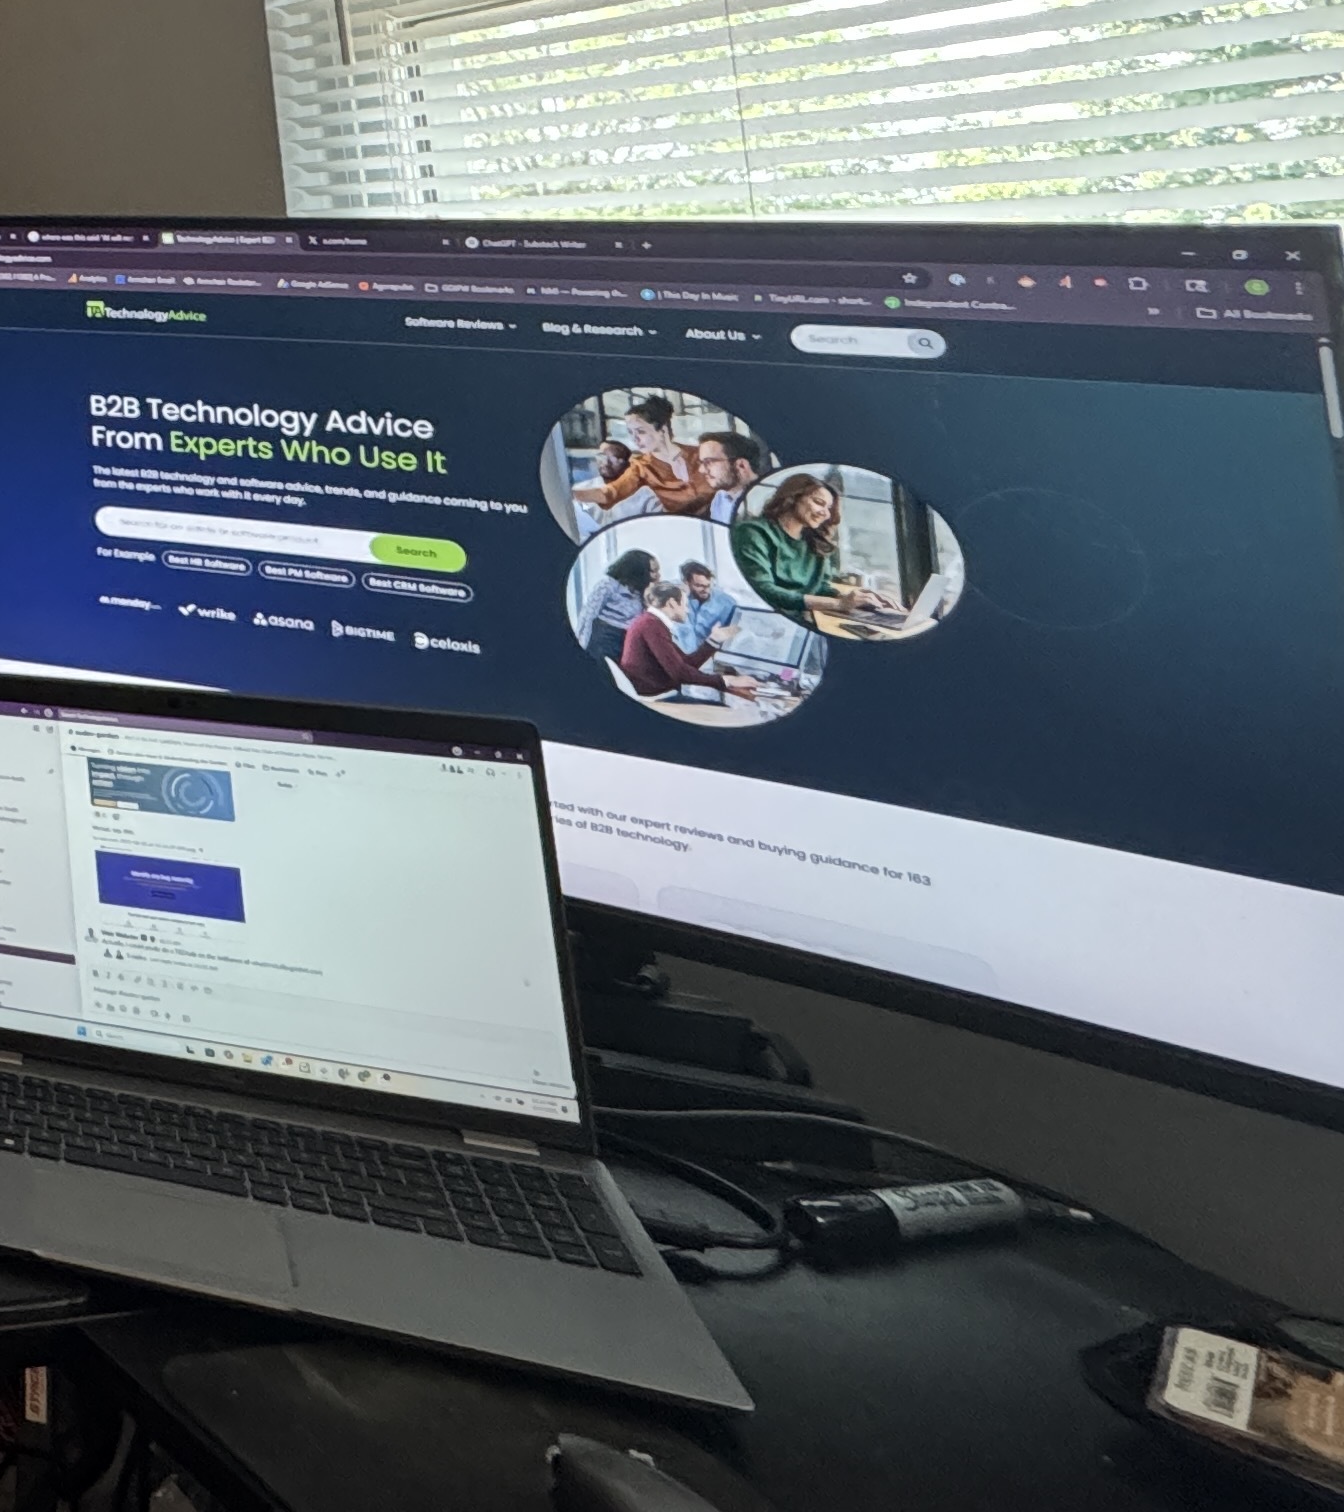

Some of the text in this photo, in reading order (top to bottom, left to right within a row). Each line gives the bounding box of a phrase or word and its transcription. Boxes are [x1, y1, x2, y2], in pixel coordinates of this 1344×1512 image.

[104, 306, 207, 324] TechnologyAdvice
[405, 316, 504, 331] Software Reviews
[542, 321, 643, 336] Blog & Research
[686, 328, 746, 342] About Us
[809, 333, 858, 346] Search
[90, 395, 434, 439] B2B Technology Advice
[92, 425, 448, 475] From Experts Who Use It
[92, 465, 528, 515] The latest B2B technology and software advice, trends, and guidance coming to you
[93, 478, 282, 506] from the experts who work with it every
[96, 546, 156, 562] For Example
[396, 545, 438, 559] Search
[168, 555, 246, 571] Best HR Software
[264, 565, 349, 583] Best PM Software
[369, 577, 467, 598] Best CRM Software
[198, 607, 237, 622] wrike
[268, 615, 315, 631] asana
[345, 625, 395, 642] BIGTIME
[430, 637, 481, 656] celoxis
[575, 817, 692, 852] of B2B technology.
[577, 804, 932, 887] with our expert reviews and buying guidance for 163
